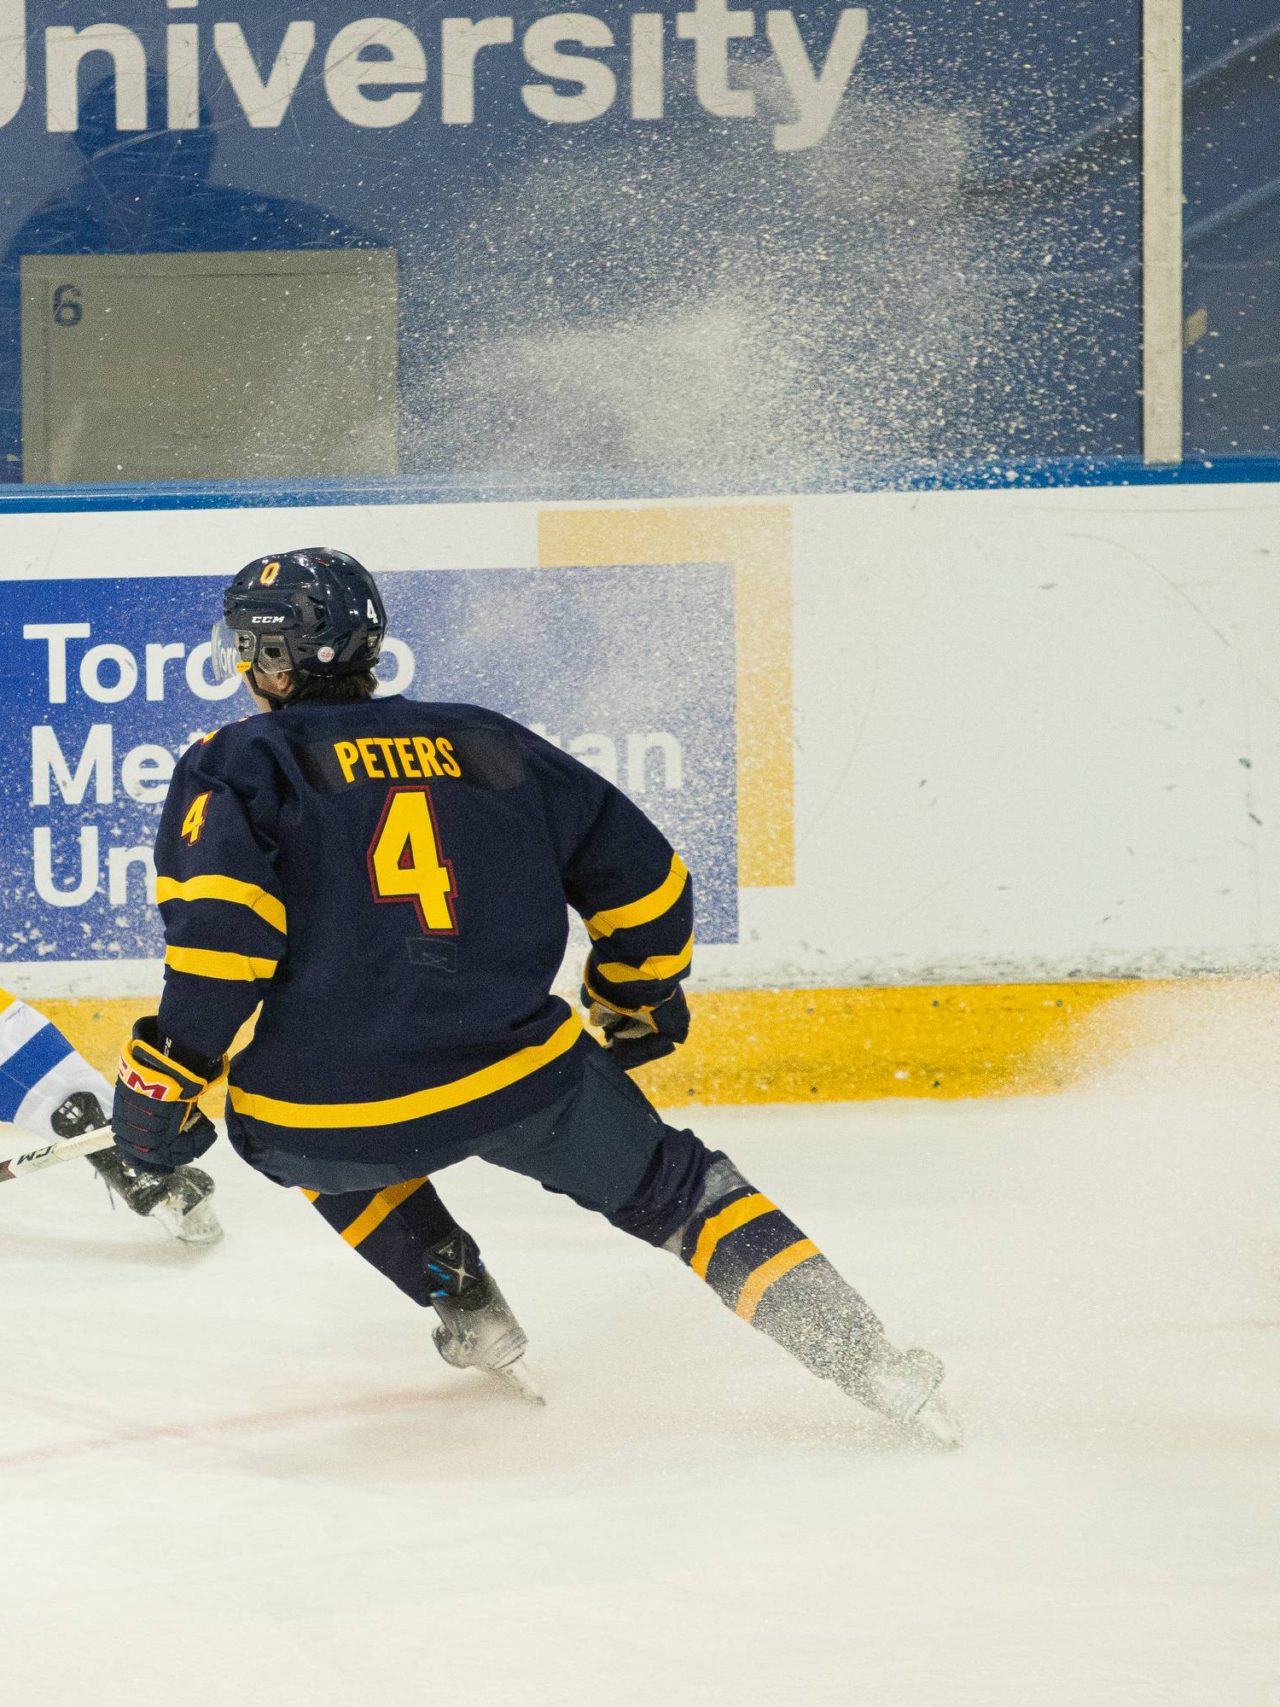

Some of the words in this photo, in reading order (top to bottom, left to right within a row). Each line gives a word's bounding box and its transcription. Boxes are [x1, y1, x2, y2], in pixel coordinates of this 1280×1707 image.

[53, 283, 82, 328] 6
[251, 615, 285, 624] CCM
[366, 599, 380, 624] 4
[23, 622, 415, 704] Toroo
[333, 736, 462, 784] PETERS
[179, 789, 213, 847] 4
[367, 785, 460, 936] 4
